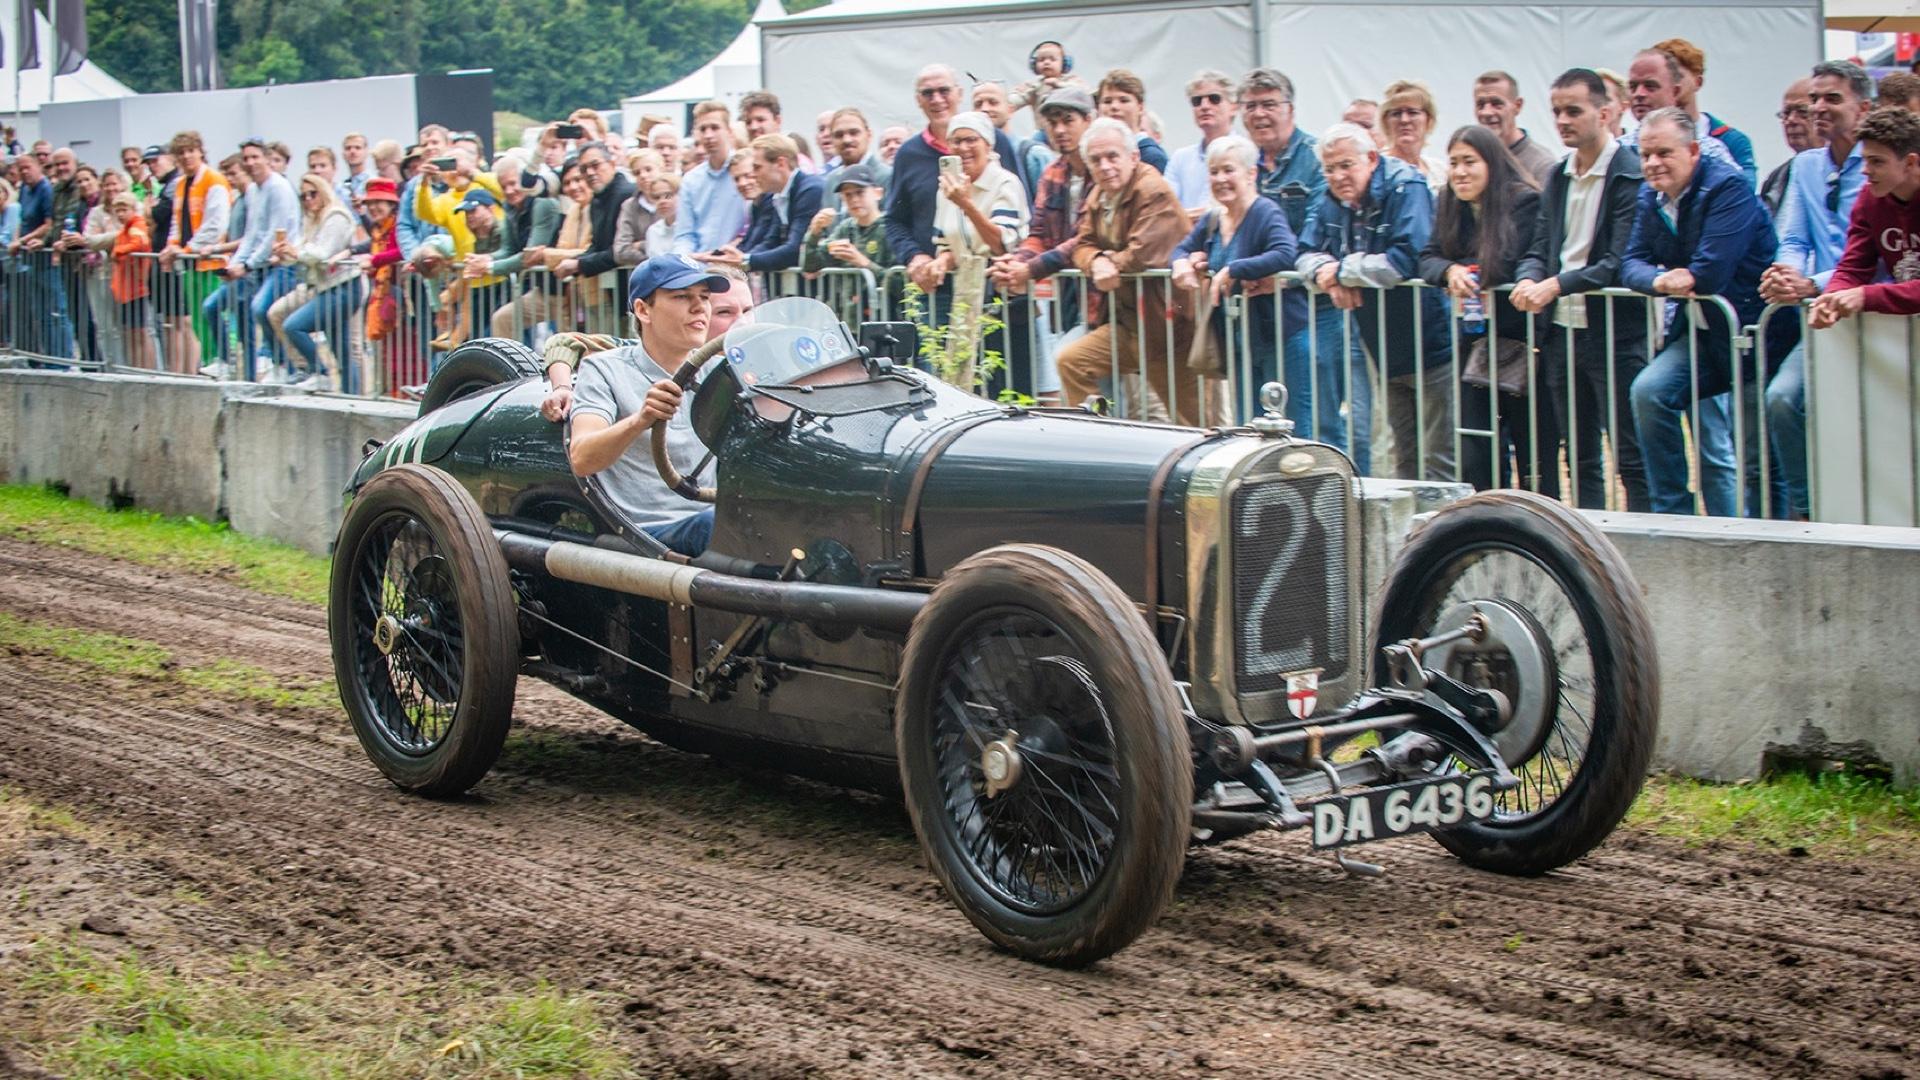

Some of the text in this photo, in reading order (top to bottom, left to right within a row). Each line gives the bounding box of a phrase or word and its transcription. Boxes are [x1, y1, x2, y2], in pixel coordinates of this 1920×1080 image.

[1240, 477, 1346, 676] 21
[1314, 775, 1493, 847] DA 6436
